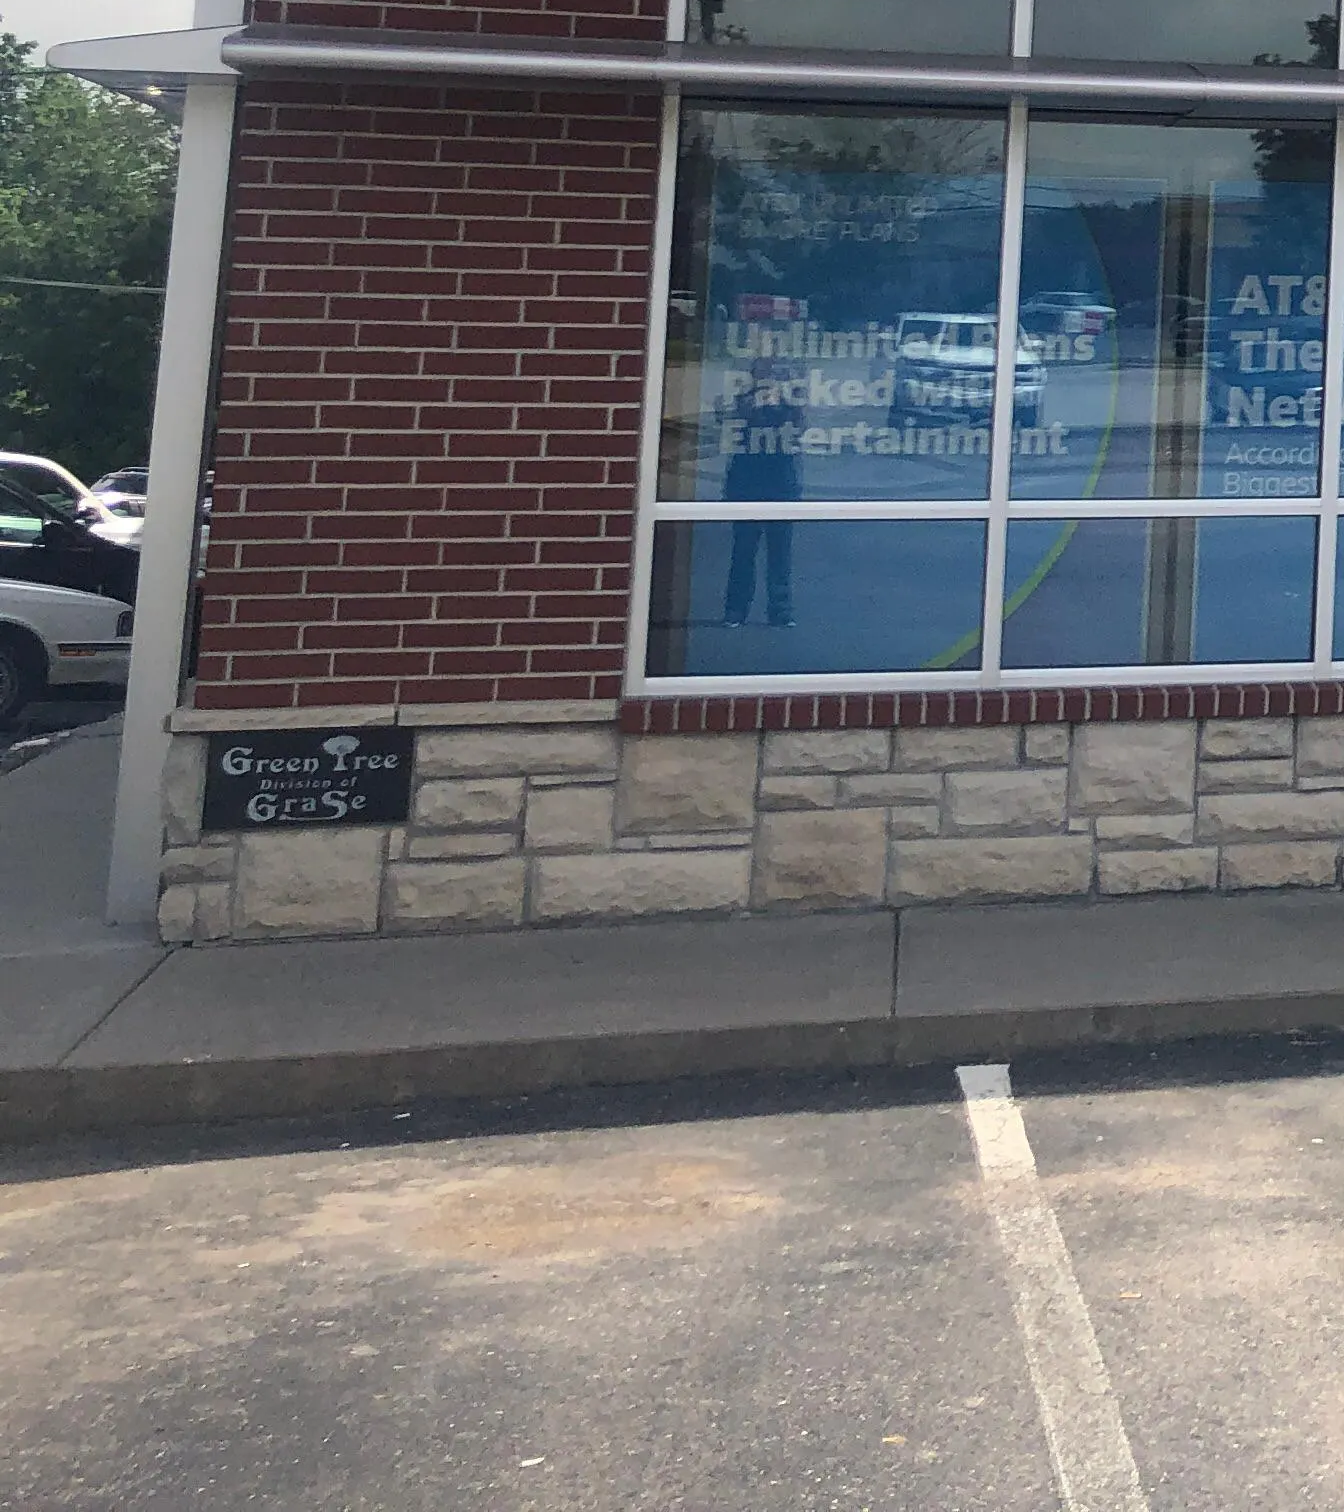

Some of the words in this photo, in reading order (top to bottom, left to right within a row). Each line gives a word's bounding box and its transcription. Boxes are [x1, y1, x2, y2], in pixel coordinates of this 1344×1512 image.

[1230, 328, 1324, 373] The
[723, 369, 894, 408] Packed
[720, 419, 1068, 455] Entertainmnt
[223, 746, 319, 776] Green
[322, 736, 398, 771] Tree
[260, 778, 331, 790] Division
[340, 776, 357, 787] of
[247, 790, 366, 822] GraSe
